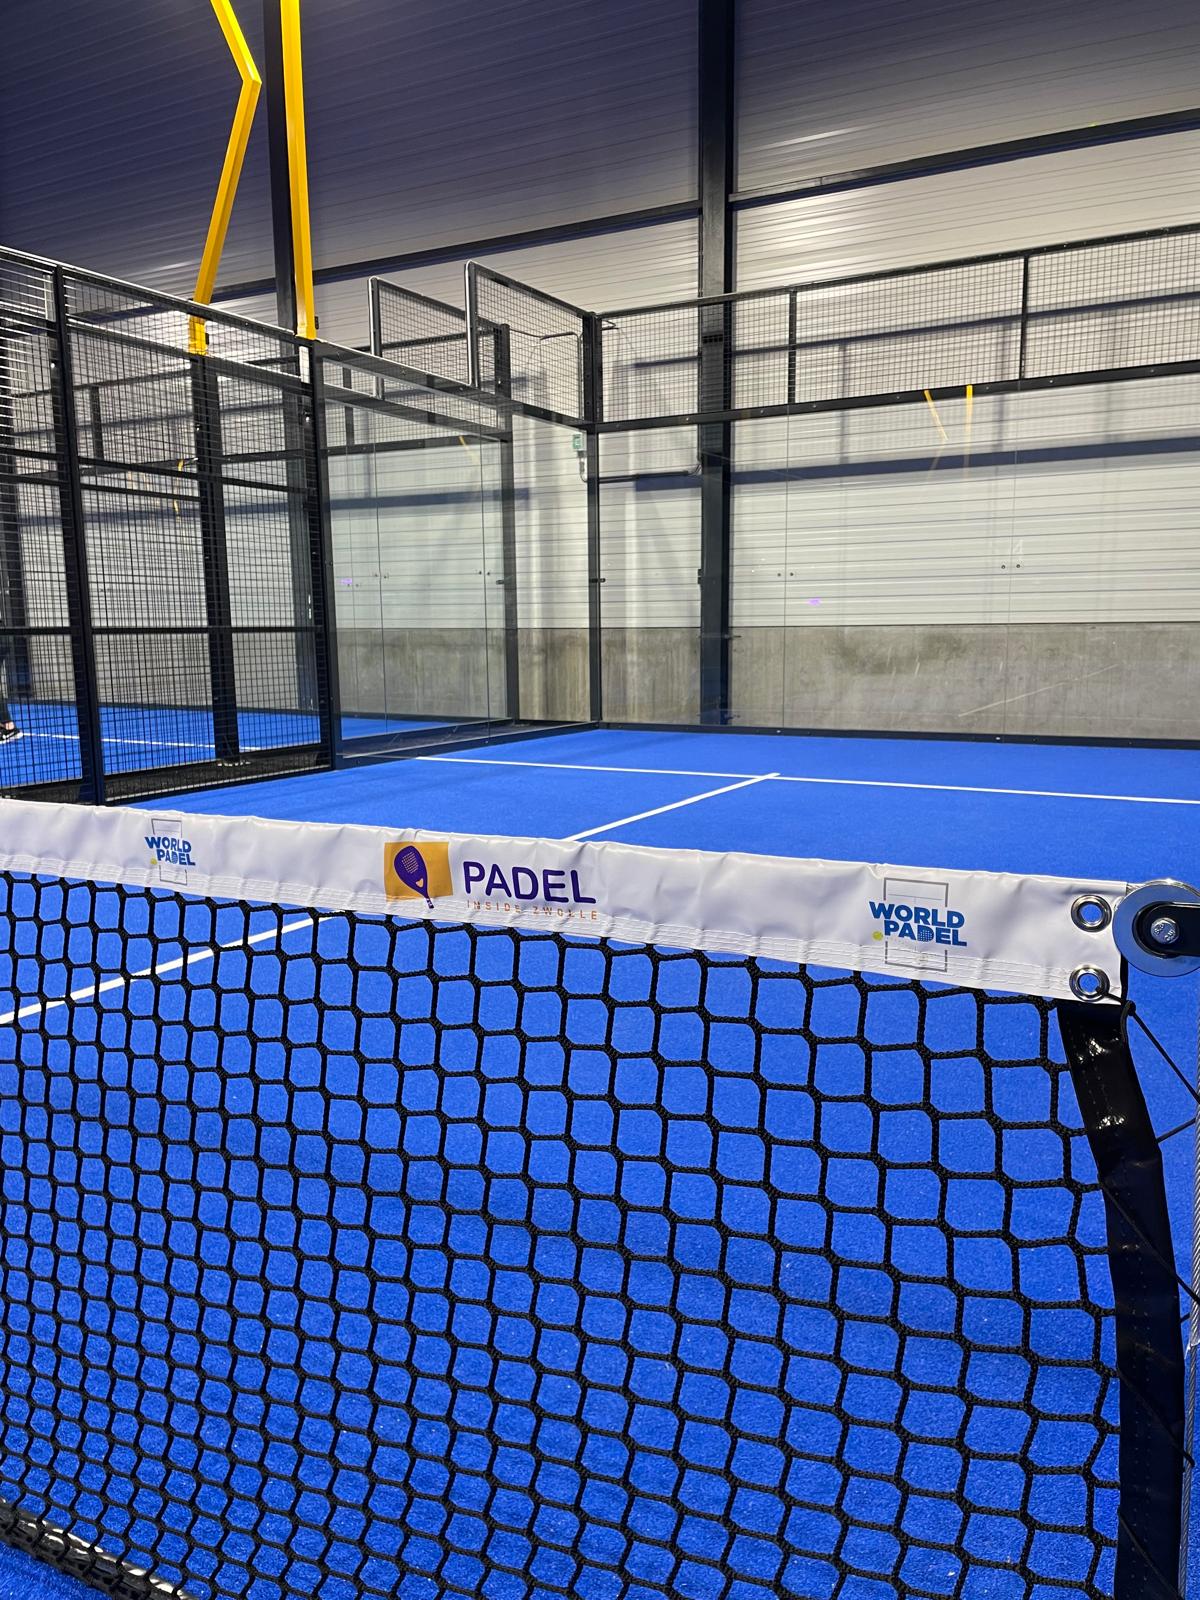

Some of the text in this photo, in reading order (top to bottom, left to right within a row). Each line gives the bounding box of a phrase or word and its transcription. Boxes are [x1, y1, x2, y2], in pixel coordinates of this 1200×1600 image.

[144, 837, 192, 853] WORLD
[156, 849, 196, 866] PADEL
[462, 861, 597, 904] PADEL
[467, 900, 521, 913] INSIDE
[869, 901, 965, 929] WORLD
[884, 920, 968, 947] PADEL
